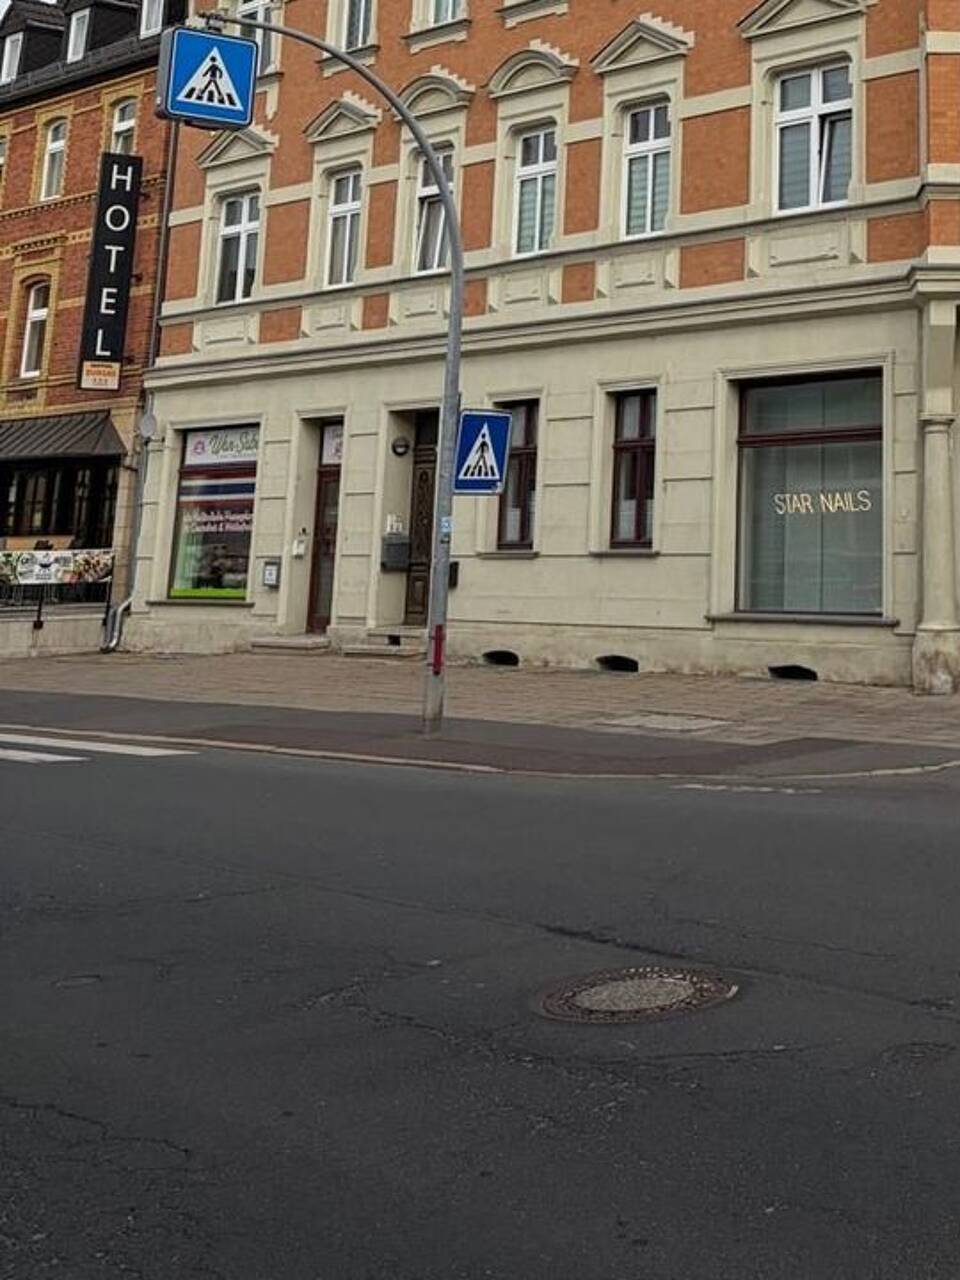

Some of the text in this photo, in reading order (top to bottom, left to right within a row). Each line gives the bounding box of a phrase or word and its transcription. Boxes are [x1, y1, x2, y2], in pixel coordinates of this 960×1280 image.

[95, 164, 133, 356] HOTEL
[773, 489, 872, 515] STAR NAILS
